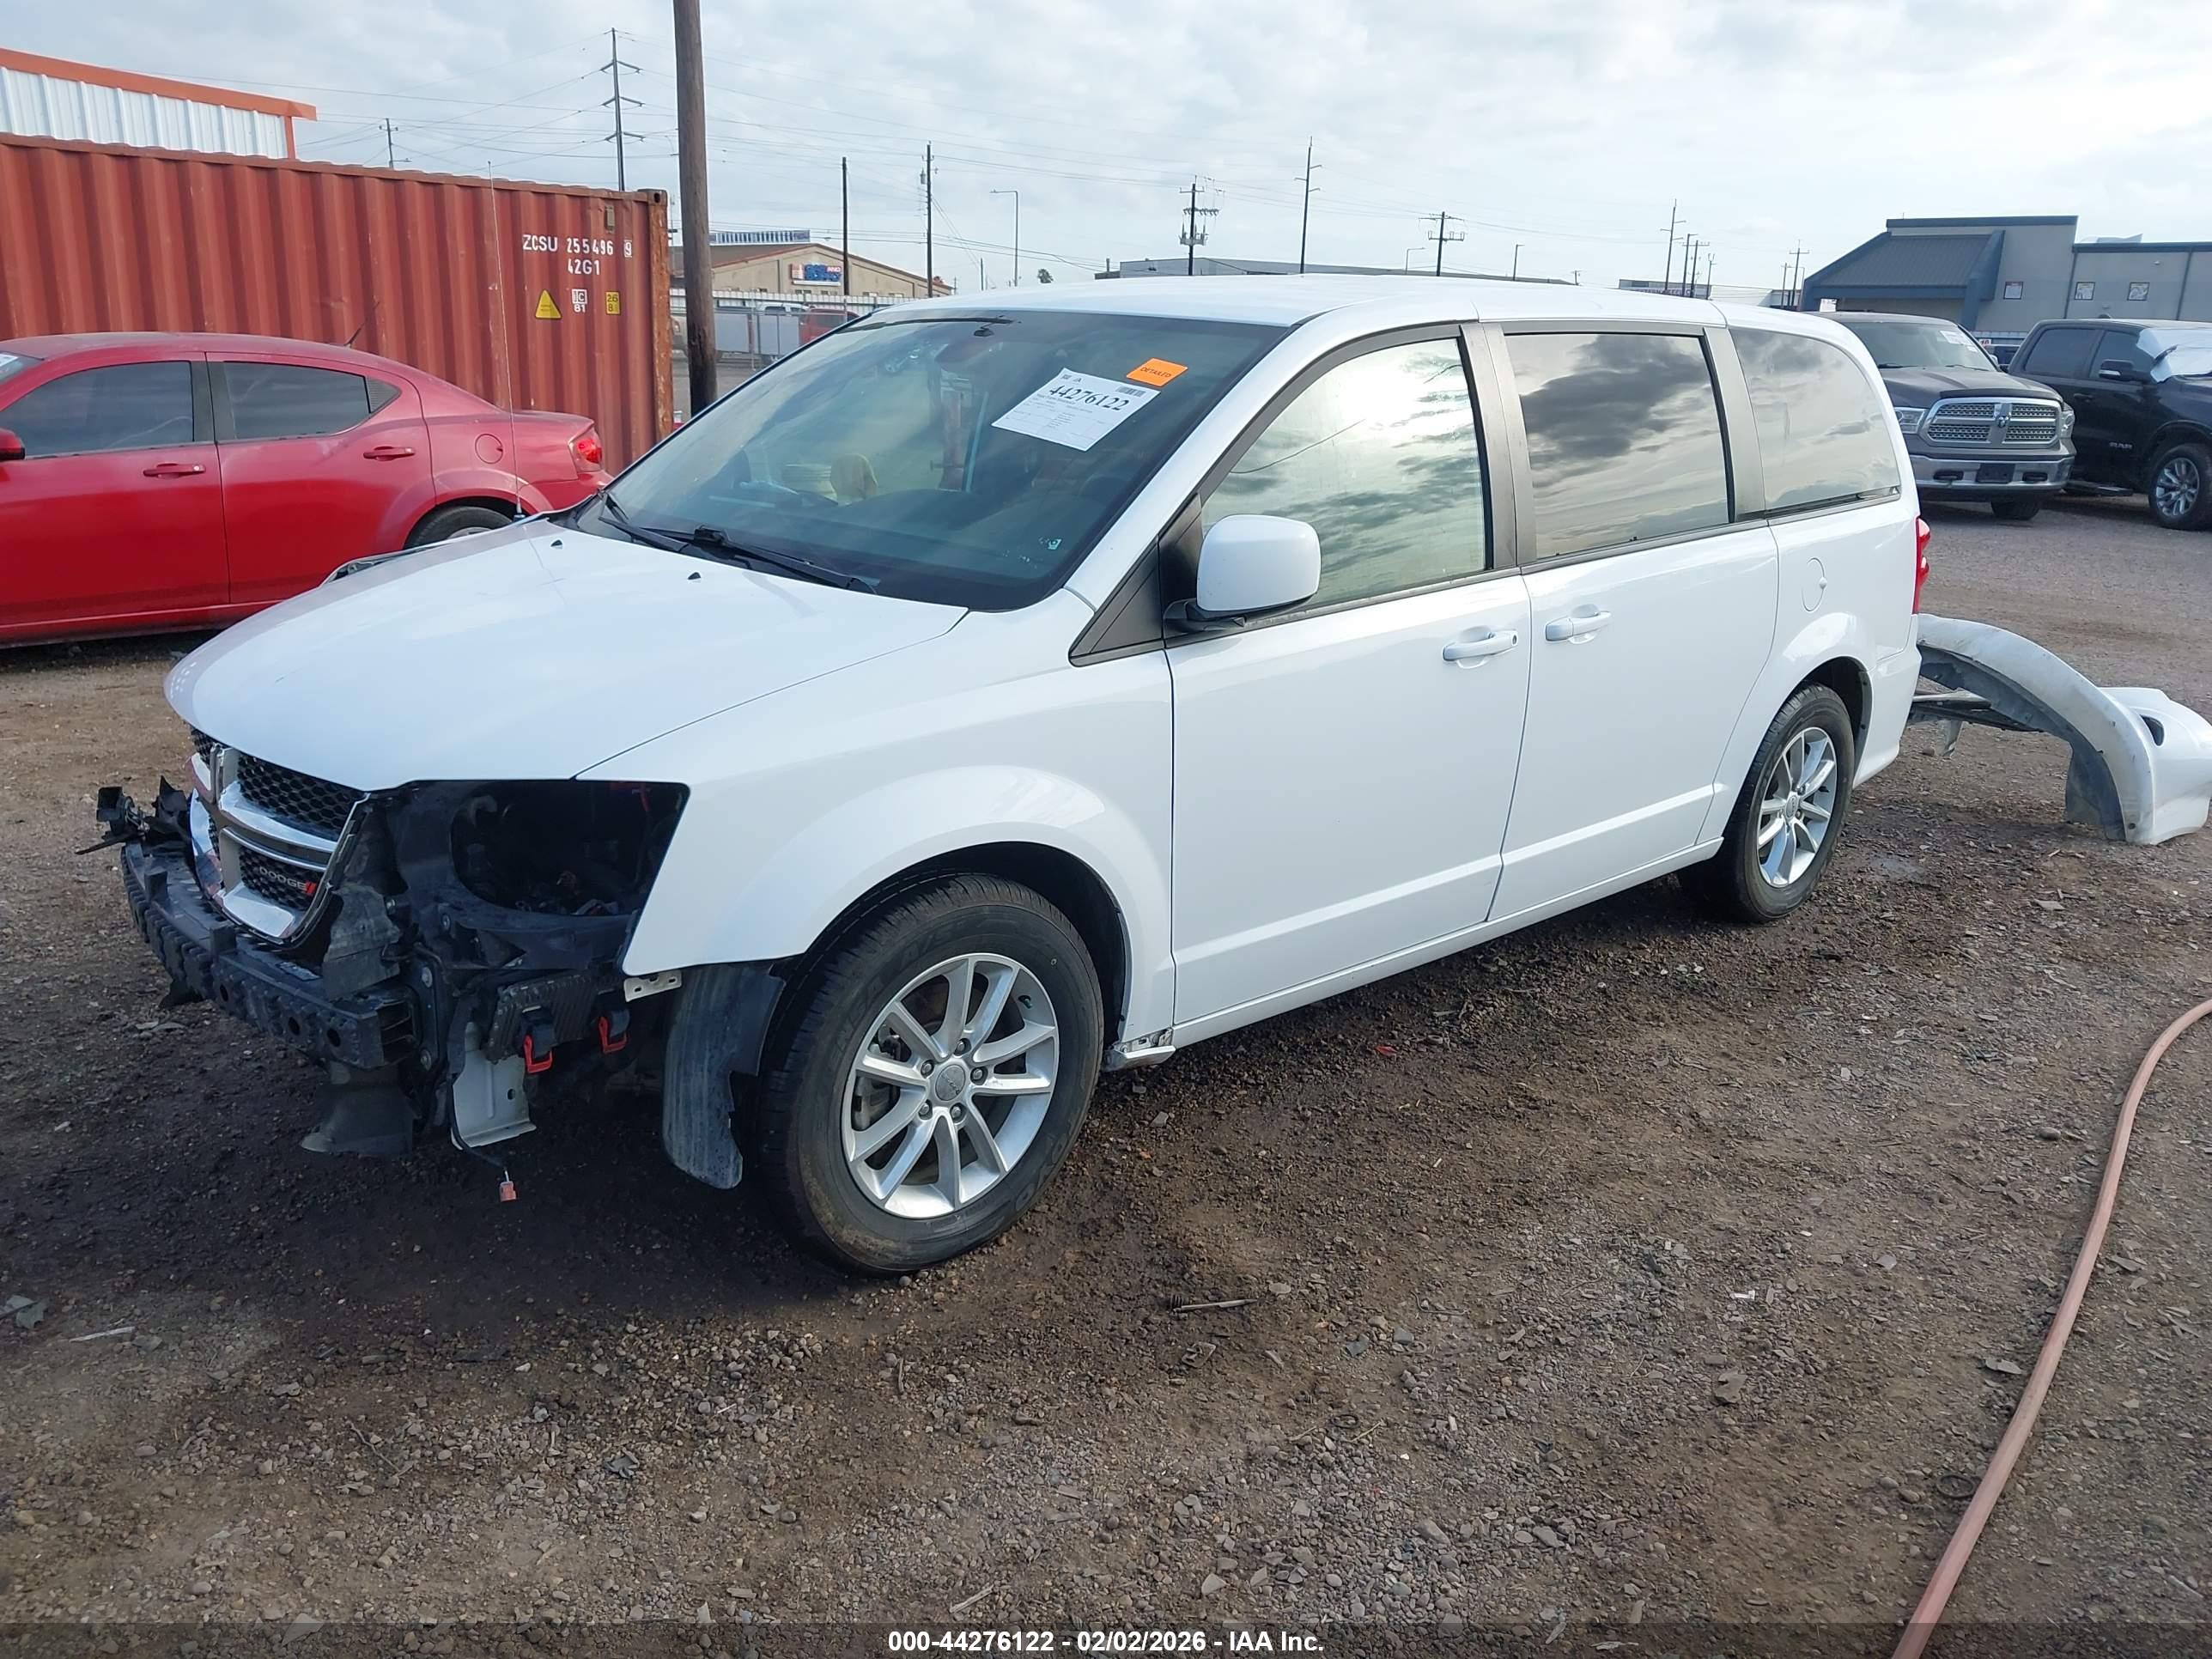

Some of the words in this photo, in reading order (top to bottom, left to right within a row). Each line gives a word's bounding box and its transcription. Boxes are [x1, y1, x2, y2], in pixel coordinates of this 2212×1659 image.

[522, 234, 557, 252] ZCSU
[567, 237, 613, 255] 255496
[568, 258, 599, 275] 42G1
[574, 304, 586, 313] 81
[1049, 385, 1130, 411] 44276122
[259, 866, 307, 892] DODGE
